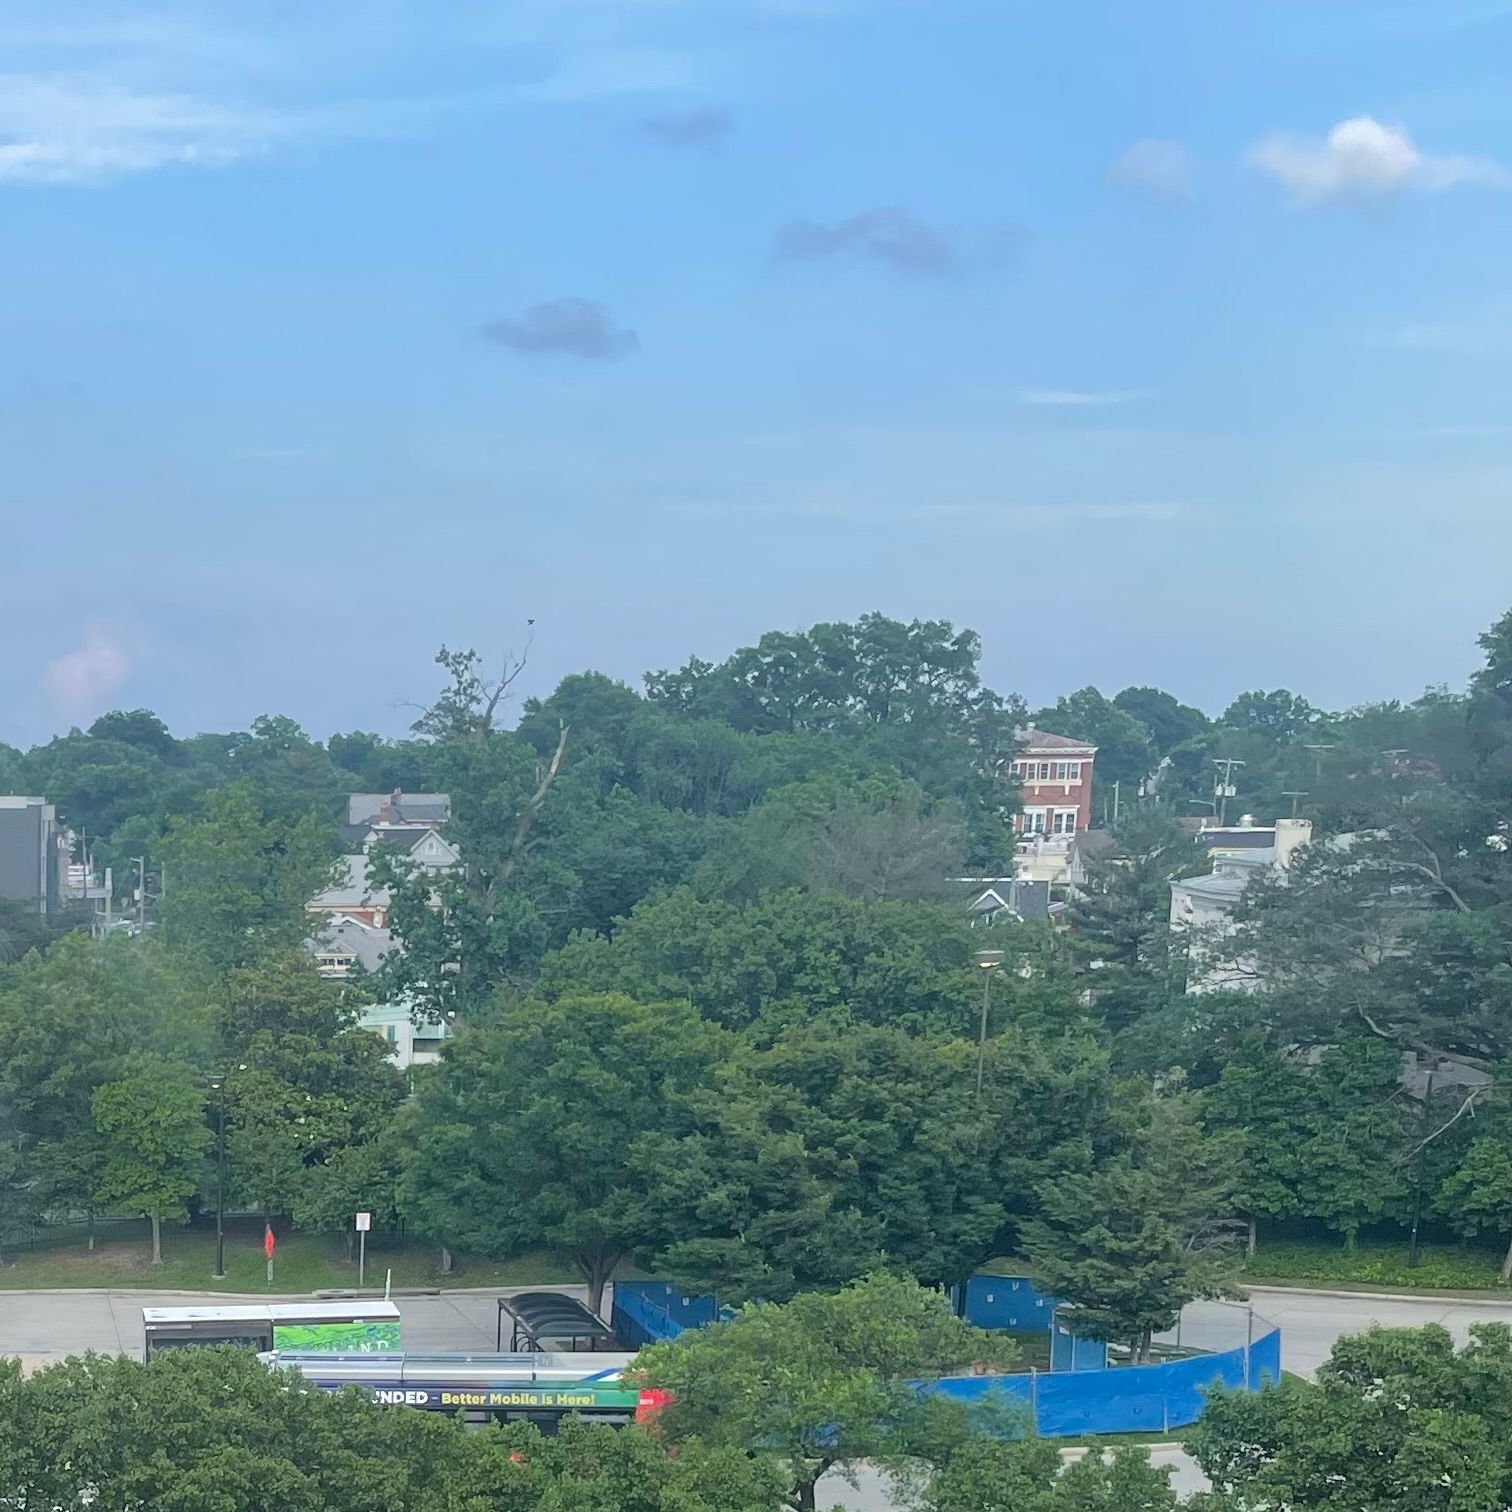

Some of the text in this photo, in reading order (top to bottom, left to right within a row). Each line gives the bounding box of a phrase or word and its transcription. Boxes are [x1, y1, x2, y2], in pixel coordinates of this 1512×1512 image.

[441, 1392, 487, 1405] Better
[490, 1393, 537, 1405] Mobile
[557, 1393, 595, 1405] Here!
